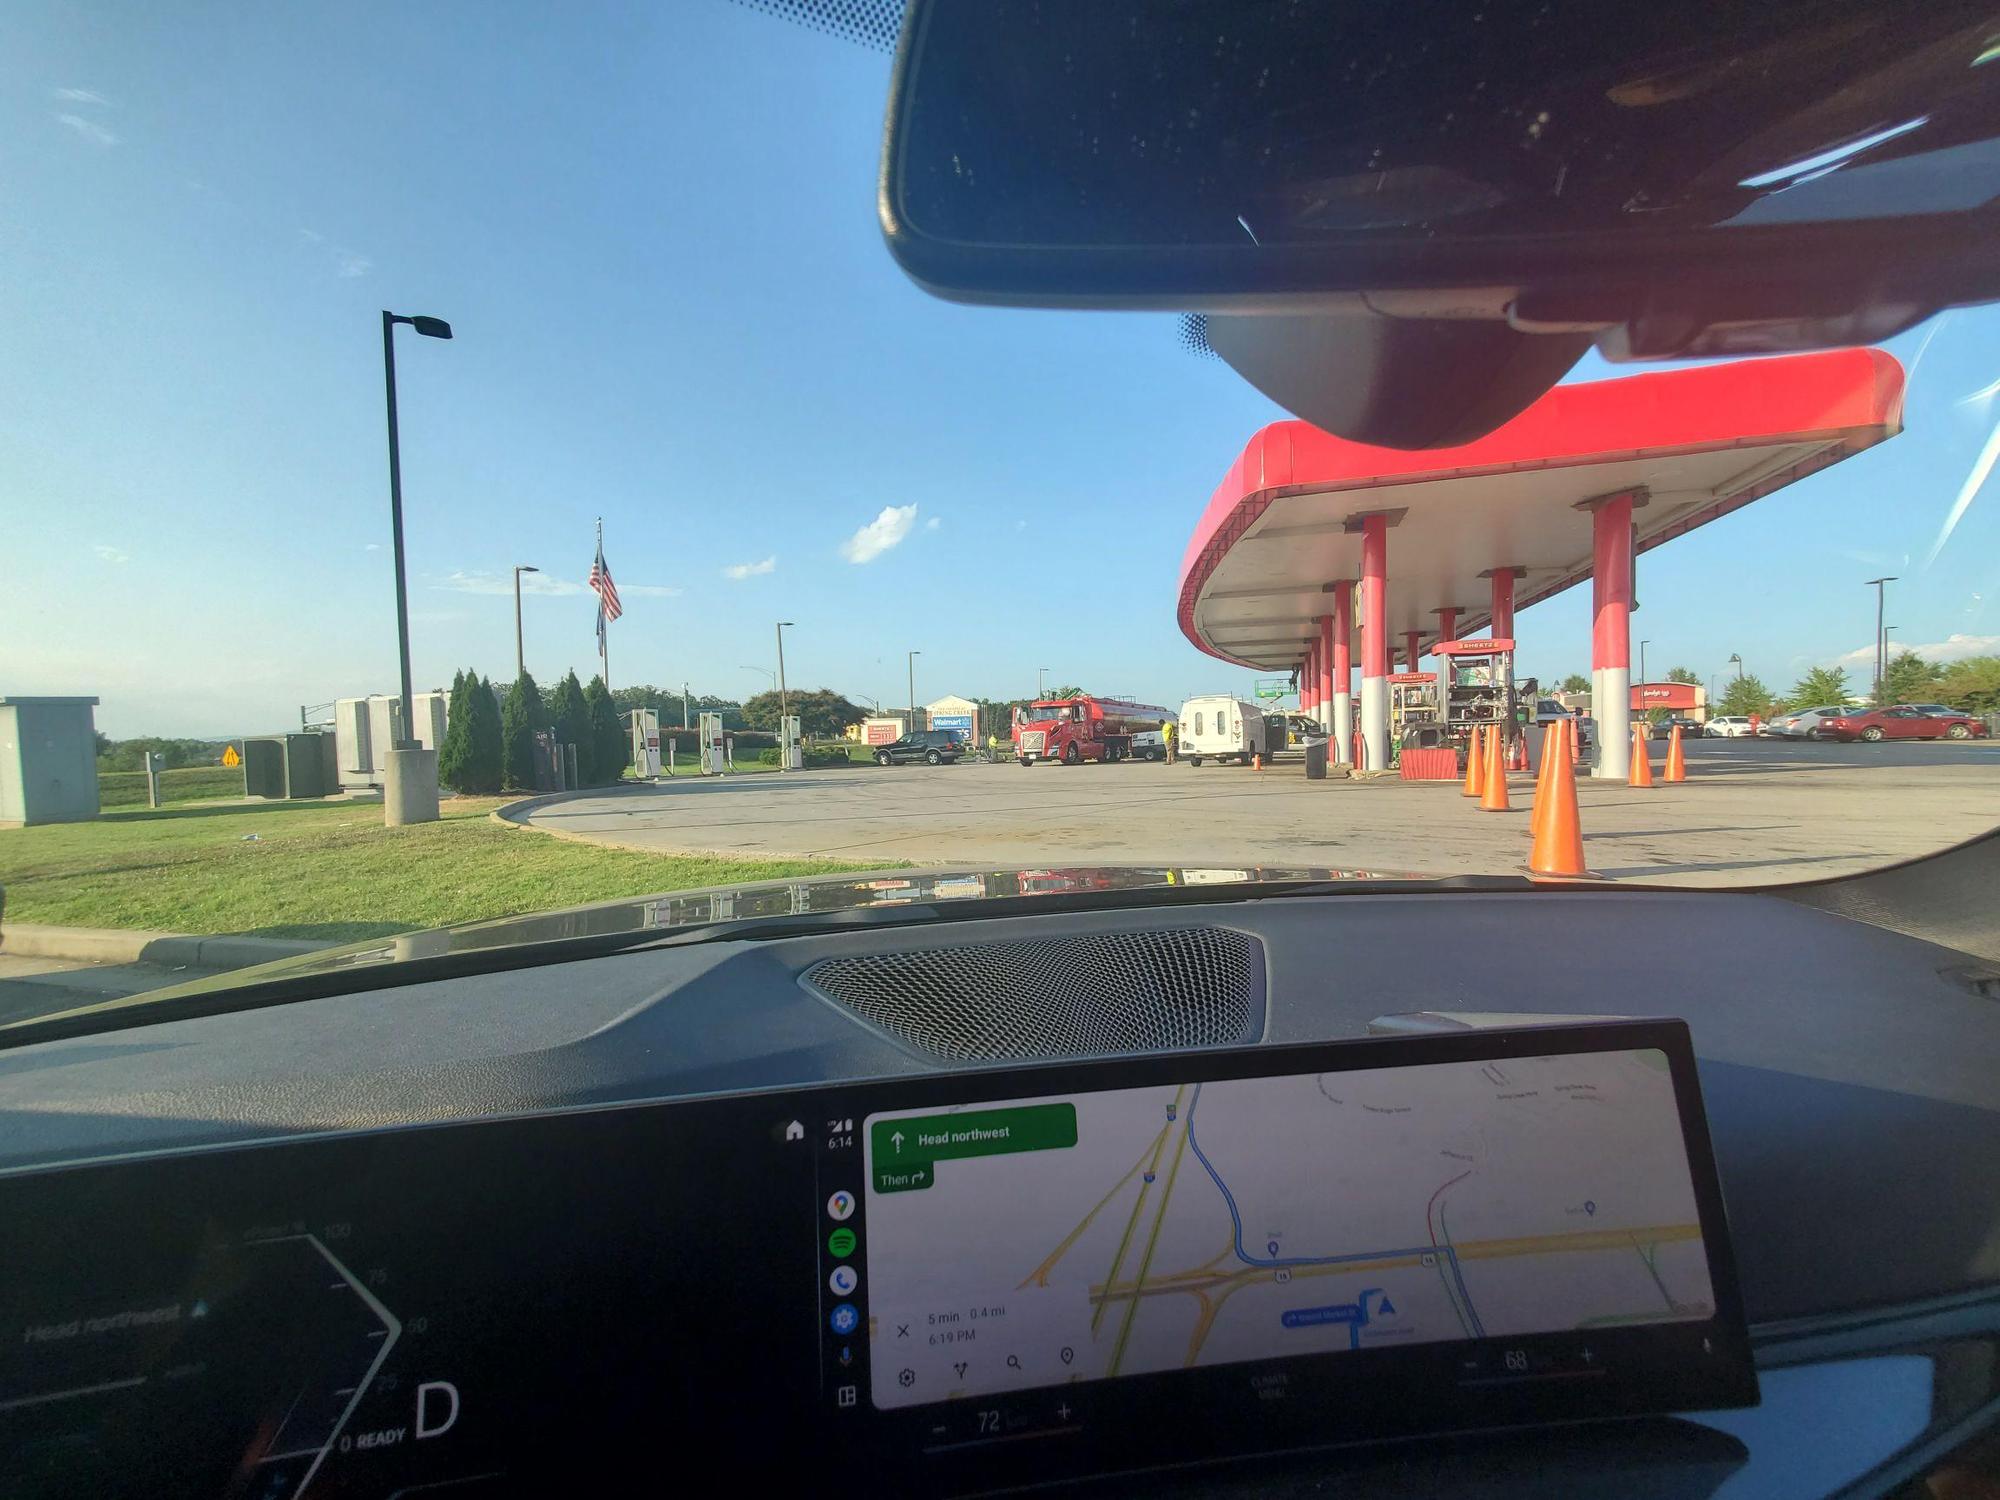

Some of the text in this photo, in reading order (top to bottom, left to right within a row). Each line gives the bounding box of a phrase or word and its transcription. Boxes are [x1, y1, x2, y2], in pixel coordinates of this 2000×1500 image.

[933, 718, 962, 726] Walmart
[828, 1135, 852, 1150] 6:14
[918, 1126, 1010, 1147] Head northwest
[881, 1174, 908, 1187] Then
[928, 1306, 1005, 1325] 5 min 0.4 mi
[929, 1328, 976, 1346] 6:19 PM
[1505, 1350, 1528, 1370] 68
[416, 1381, 459, 1439] D
[978, 1410, 1000, 1433] 72
[357, 1427, 406, 1448] READY
